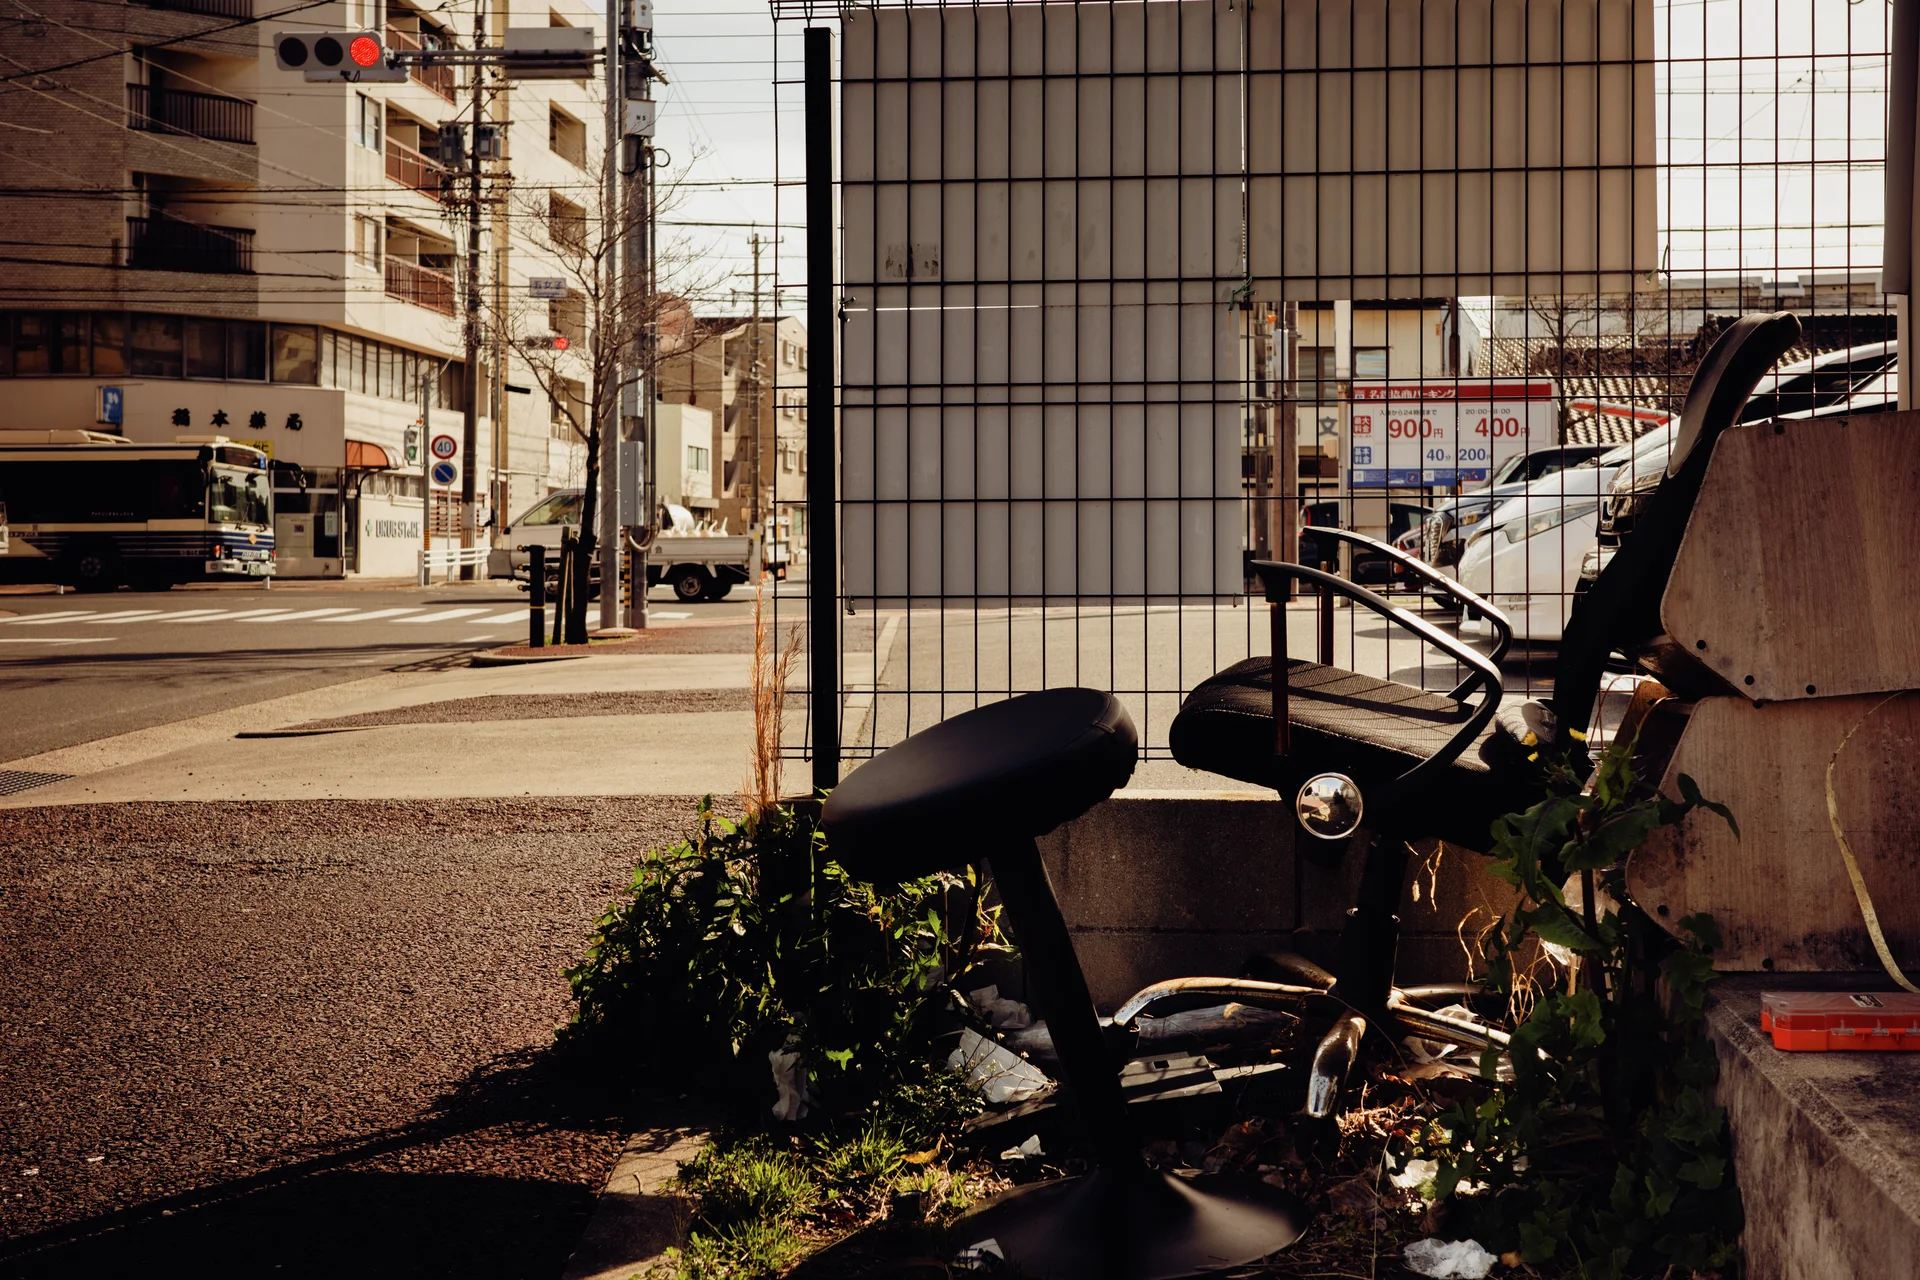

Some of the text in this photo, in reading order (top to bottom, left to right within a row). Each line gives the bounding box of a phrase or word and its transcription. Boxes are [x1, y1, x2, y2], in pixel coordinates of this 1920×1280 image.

[1388, 418, 1443, 439] 900円
[1475, 417, 1530, 437] 400円
[436, 441, 452, 454] 40
[375, 519, 397, 538] DRUG
